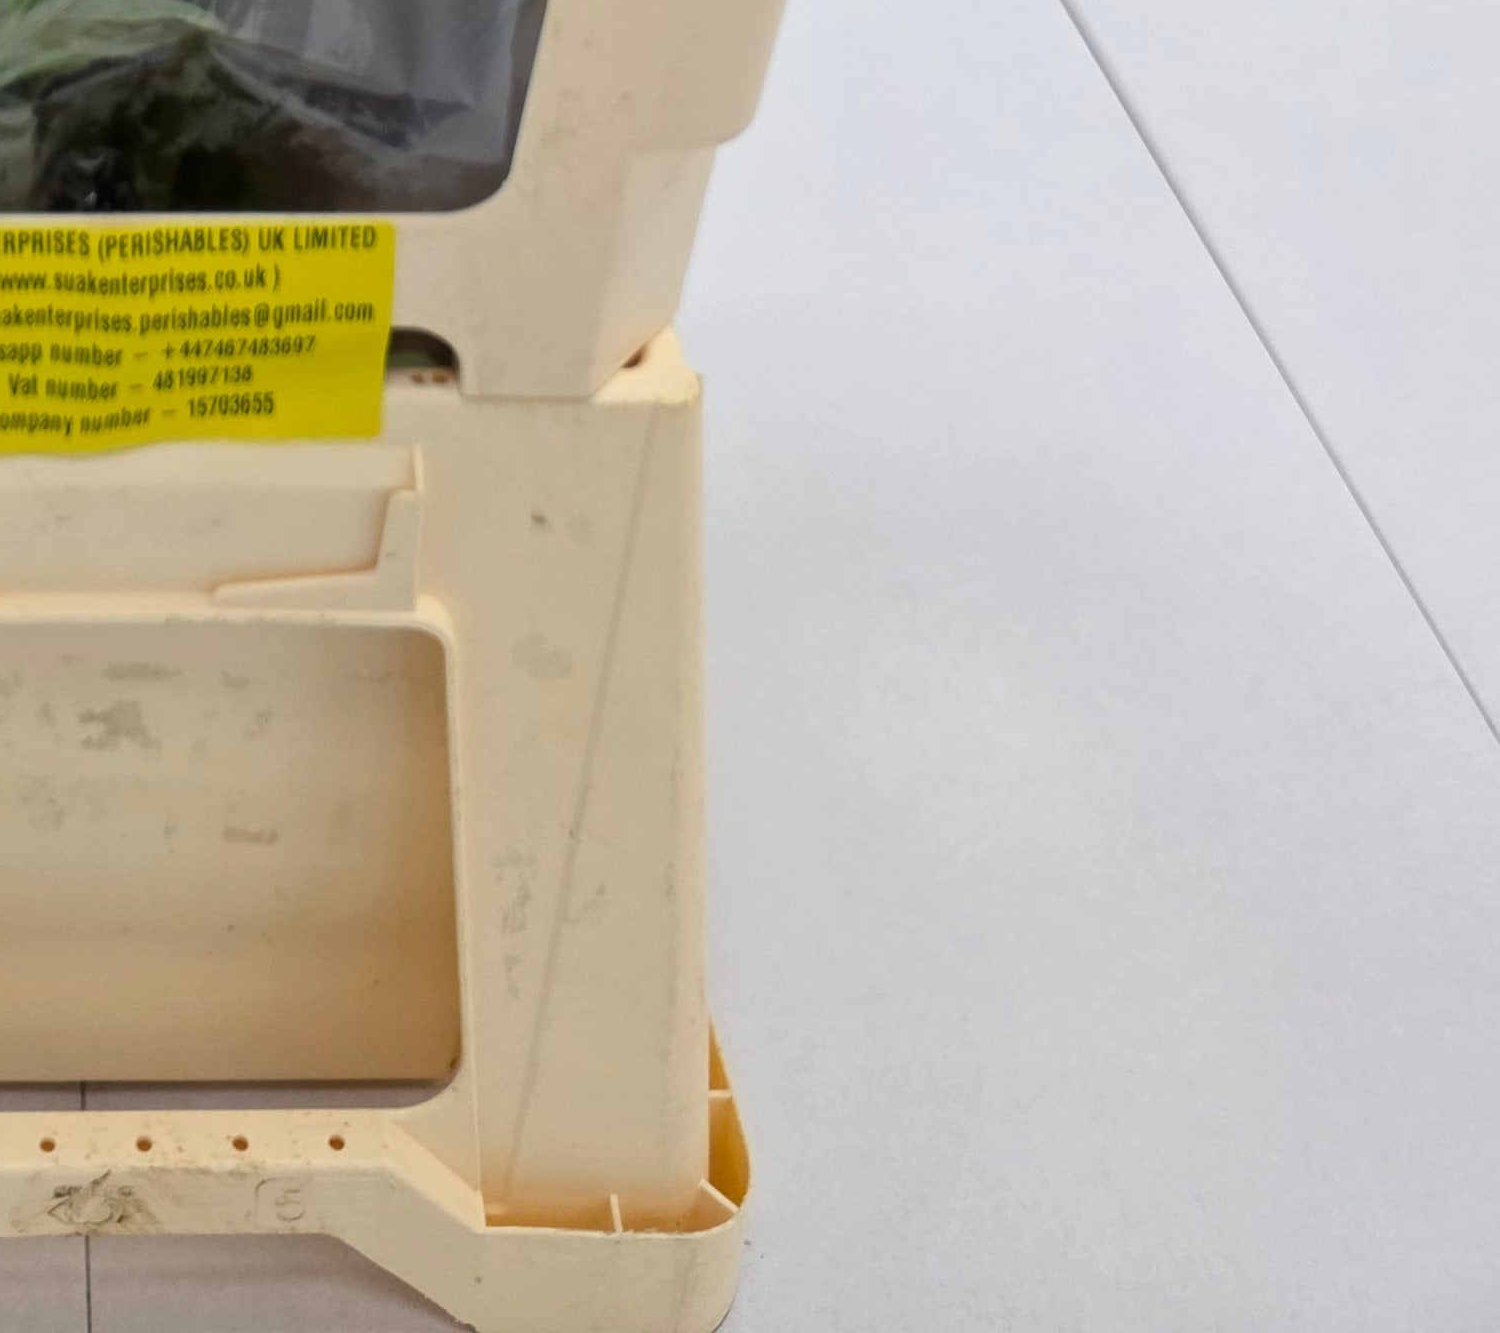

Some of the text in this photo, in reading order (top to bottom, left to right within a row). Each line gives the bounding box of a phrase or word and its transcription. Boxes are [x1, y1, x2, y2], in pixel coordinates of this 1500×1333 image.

[98, 227, 251, 263] (PERISHABLES)
[258, 227, 285, 252] UK
[293, 225, 376, 251] LIMITED
[49, 342, 124, 367] number
[8, 372, 39, 396] Vat
[44, 376, 118, 401] number
[153, 364, 254, 391] 481997138
[79, 405, 151, 434] number
[188, 390, 275, 418] 15703655
